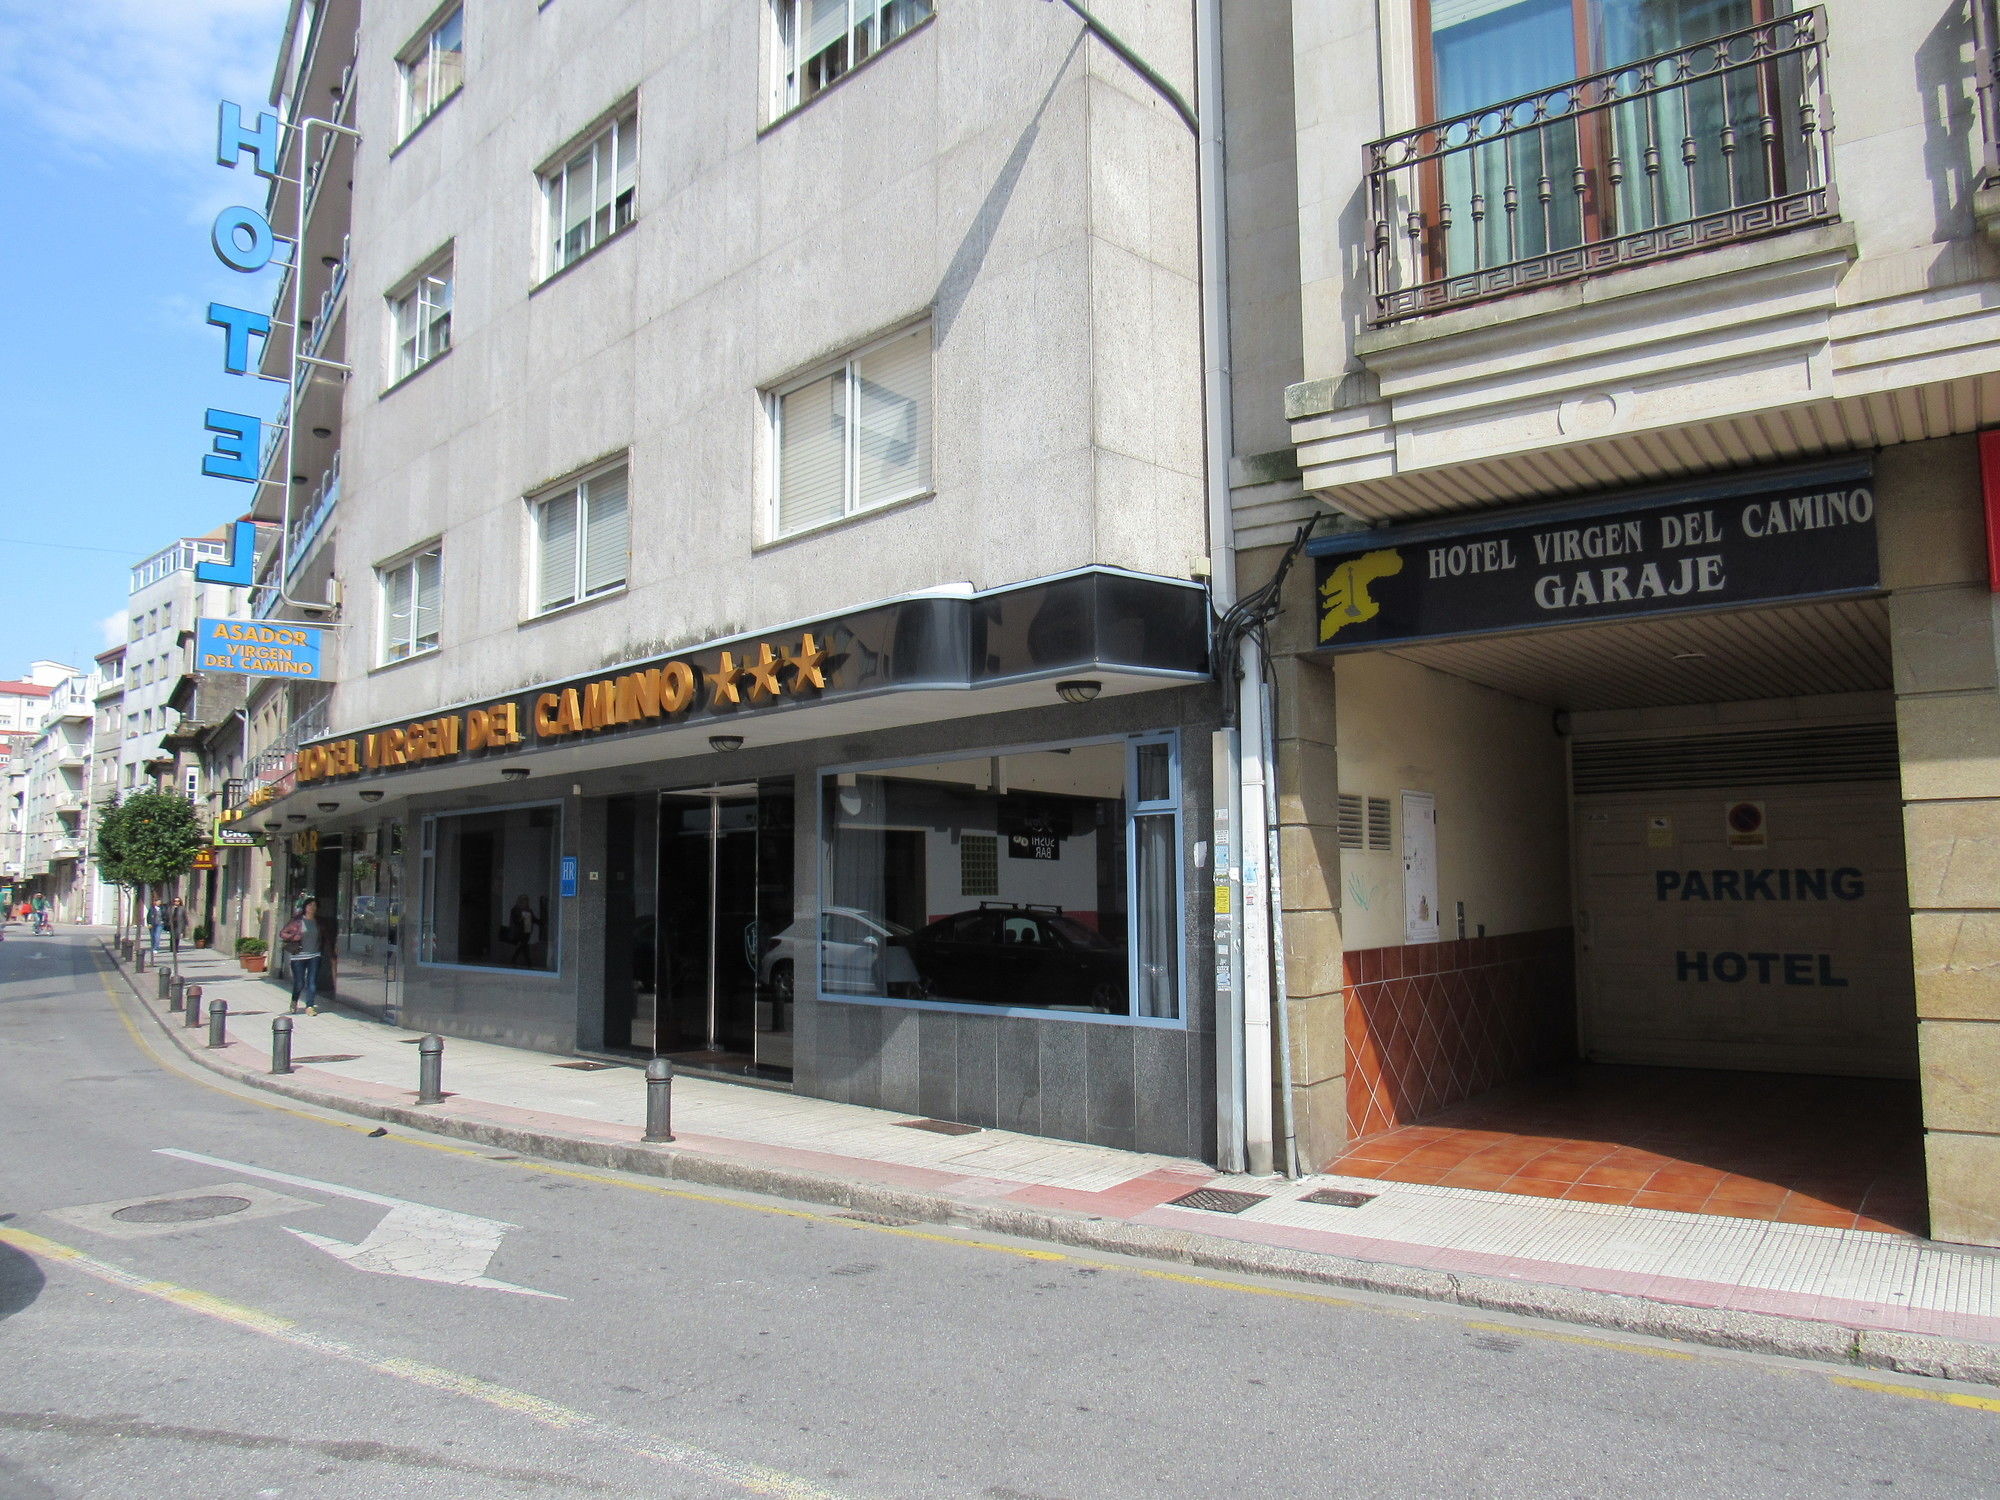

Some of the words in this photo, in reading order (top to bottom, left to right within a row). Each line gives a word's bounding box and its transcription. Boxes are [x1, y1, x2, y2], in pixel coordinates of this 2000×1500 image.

[1428, 539, 1517, 579] HOTEL
[1533, 520, 1643, 564] VIRGEN
[1661, 510, 1723, 549] DEL
[1741, 487, 1874, 538] CAMINO
[1533, 554, 1727, 611] GARAJE
[213, 623, 309, 647] ASADOR
[227, 643, 293, 661] VIRGEN
[205, 654, 235, 668] DEL
[241, 658, 314, 675] CAMINO
[297, 738, 363, 782] HOTEL
[364, 716, 460, 768] VIRGEN
[467, 702, 520, 749] DEL
[535, 661, 695, 736] CAMINO
[1656, 867, 1865, 901] PARKING
[1675, 951, 1849, 987] HOTEL
